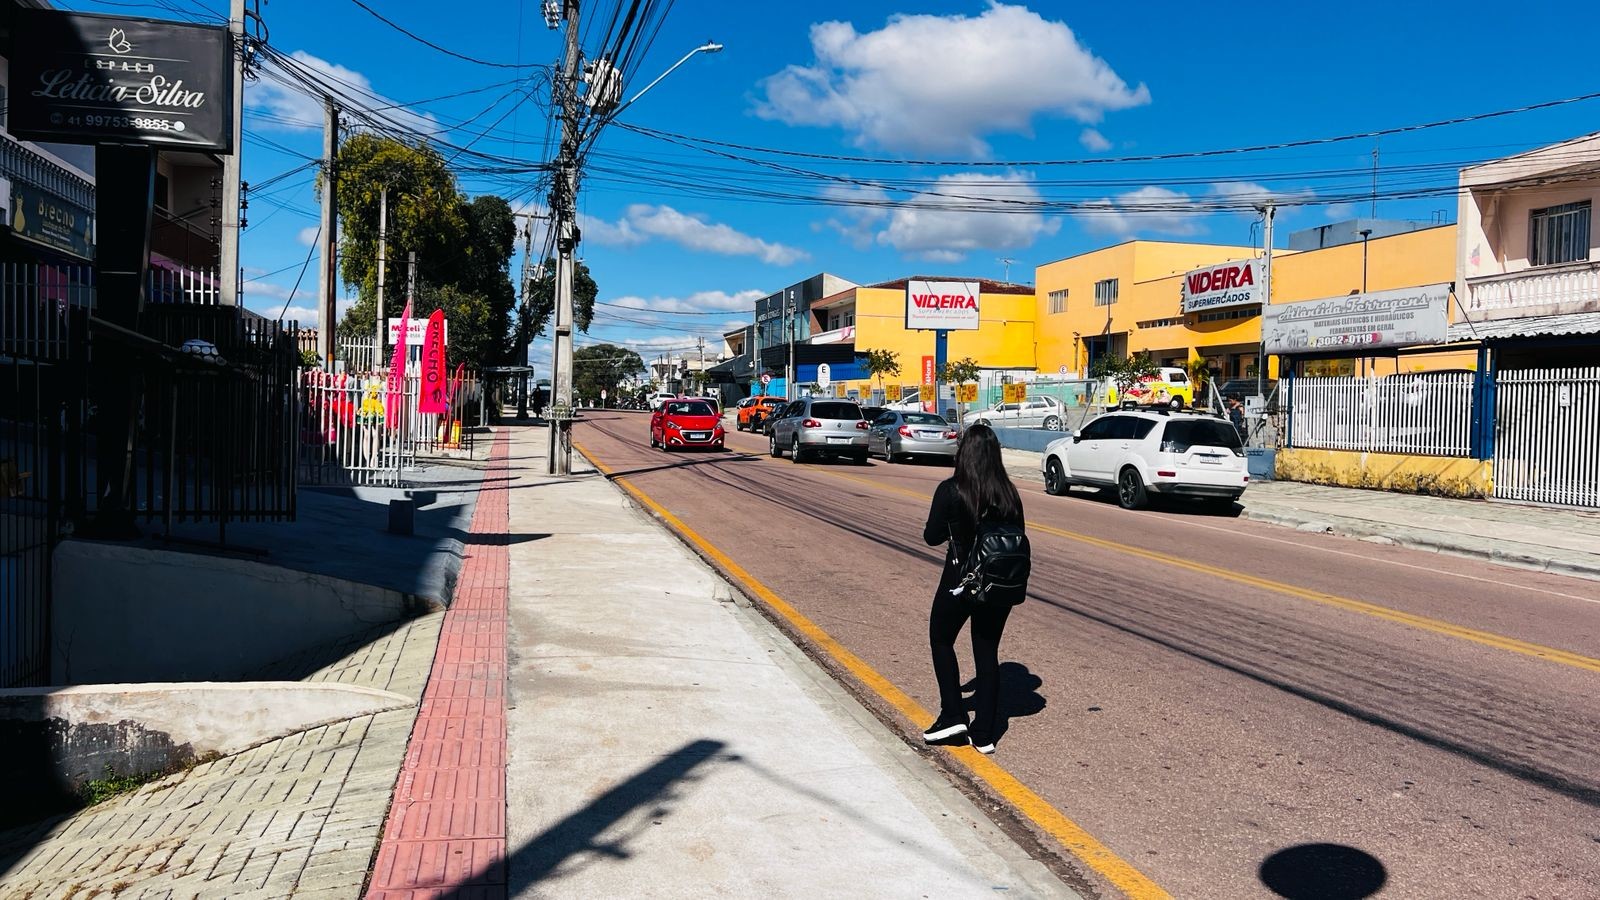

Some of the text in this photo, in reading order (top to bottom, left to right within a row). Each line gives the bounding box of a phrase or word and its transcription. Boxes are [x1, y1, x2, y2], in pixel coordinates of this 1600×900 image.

[84, 60, 154, 73] ESPAÇO
[136, 75, 205, 108] Silva
[68, 116, 80, 125] 41
[1188, 264, 1253, 295] VIDEIRA
[912, 294, 977, 309] VIDEIRA
[1188, 292, 1251, 309] SUPERMERCADOS
[1345, 293, 1428, 313] Ferragens
[1313, 320, 1341, 328] MATERIAIS
[1329, 323, 1395, 335] FERRAMENTAS EM GERAL
